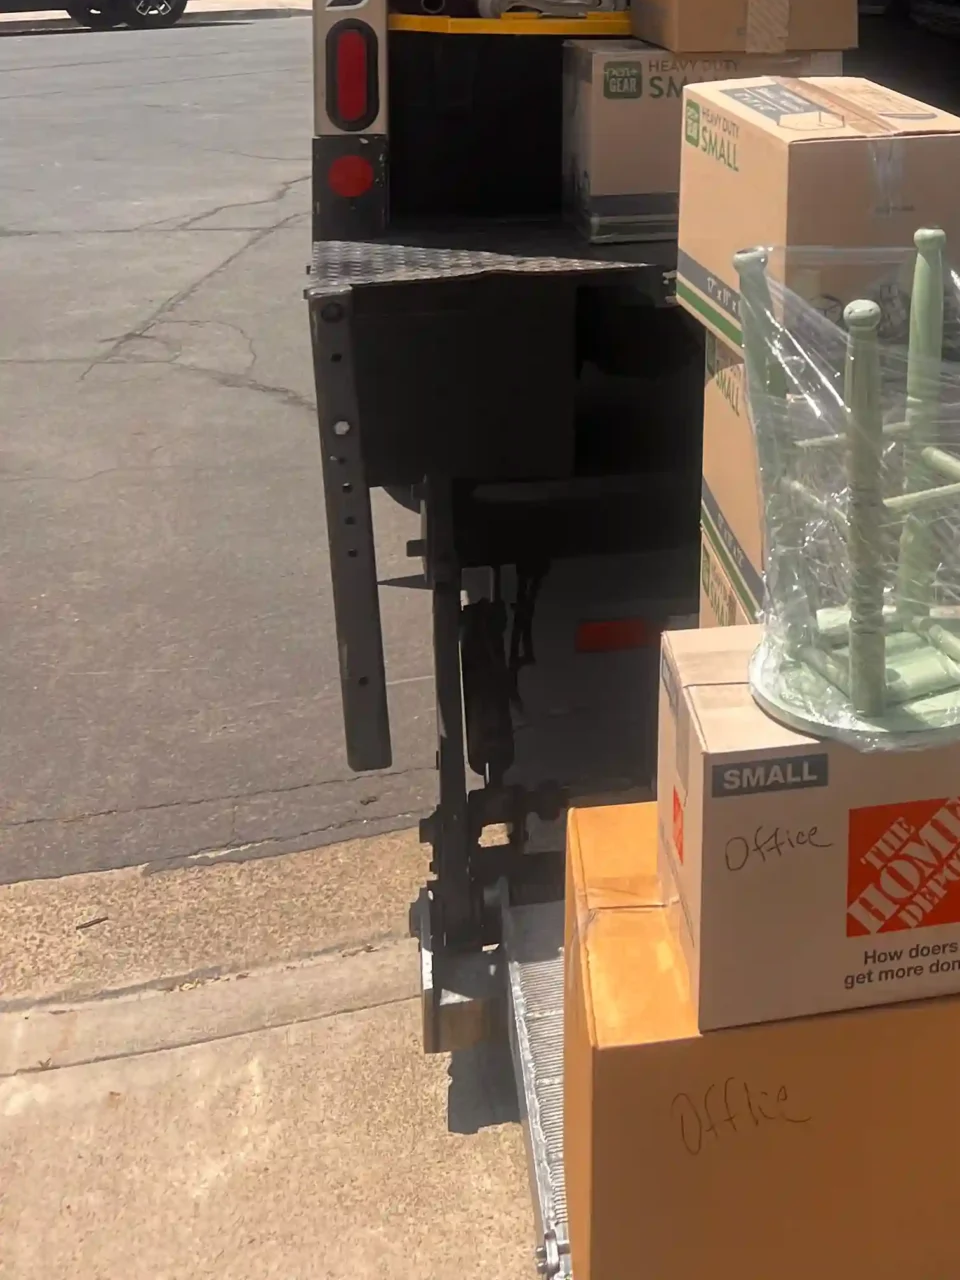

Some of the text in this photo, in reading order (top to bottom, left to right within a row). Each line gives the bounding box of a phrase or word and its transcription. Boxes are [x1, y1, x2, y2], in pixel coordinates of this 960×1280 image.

[648, 59, 740, 72] HEAVY DUTY
[609, 78, 637, 93] GEAR
[722, 117, 740, 139] DUTY
[701, 125, 739, 172] SMALL
[723, 761, 818, 790] SMALL
[725, 826, 834, 871] Office
[860, 817, 915, 870] THE
[863, 941, 959, 965] How doers
[844, 970, 874, 990] get
[878, 964, 924, 982] more
